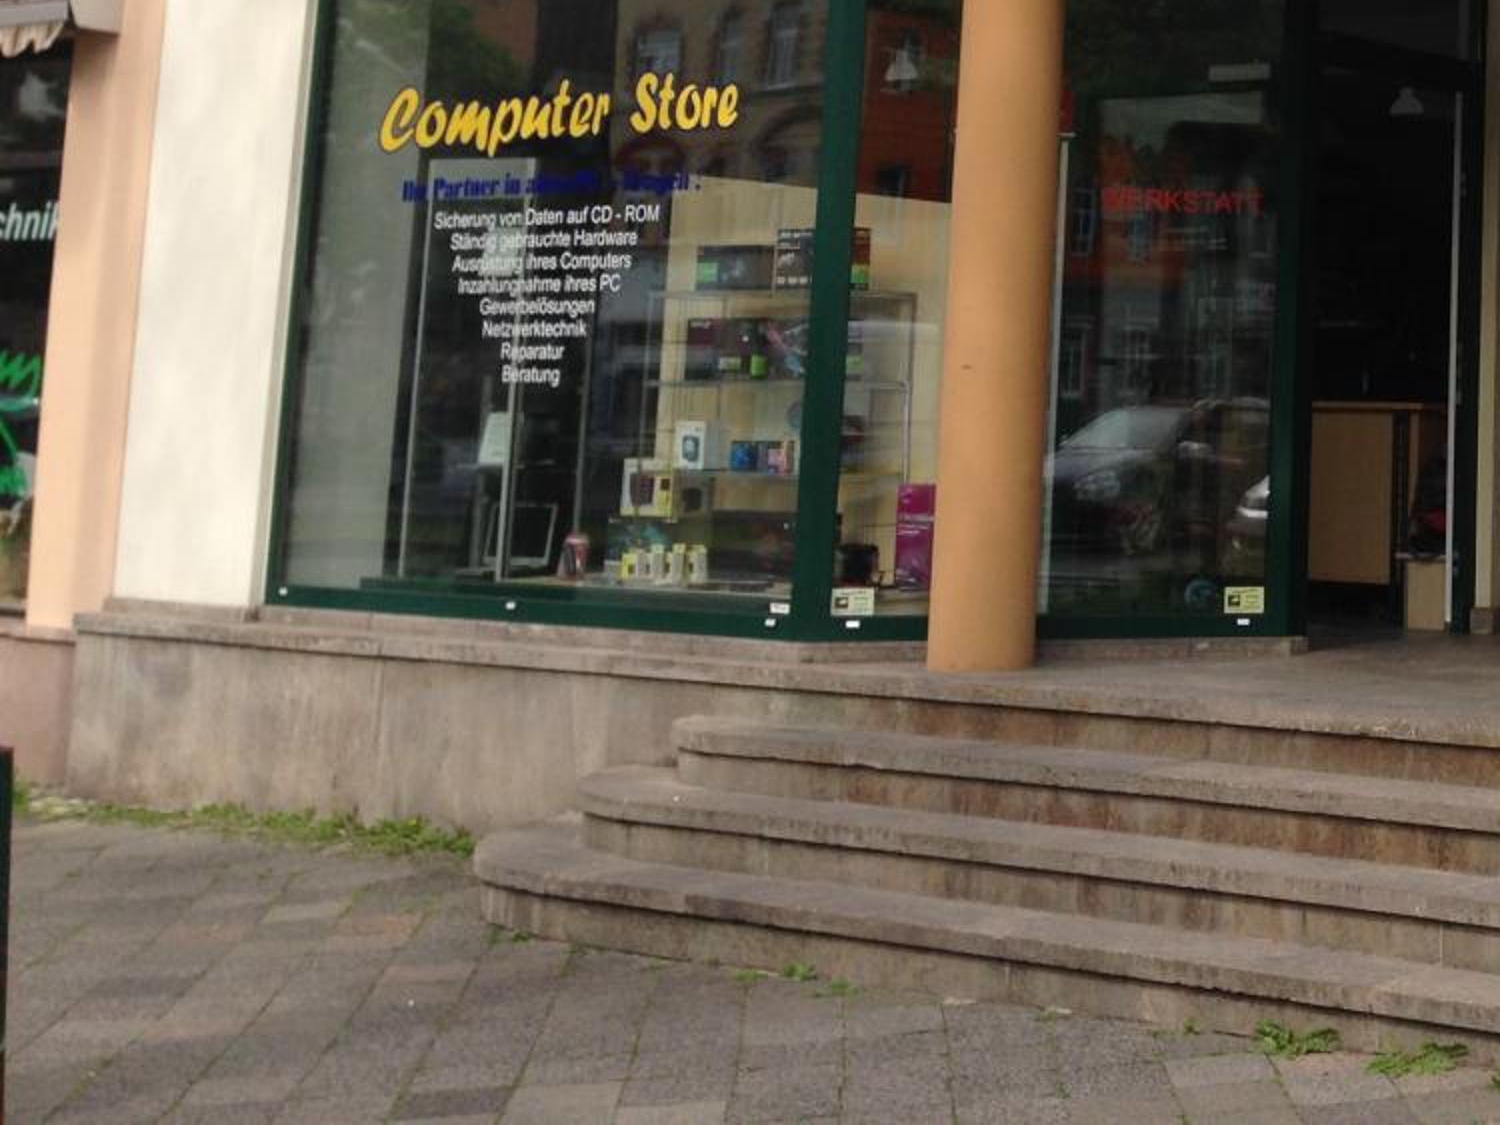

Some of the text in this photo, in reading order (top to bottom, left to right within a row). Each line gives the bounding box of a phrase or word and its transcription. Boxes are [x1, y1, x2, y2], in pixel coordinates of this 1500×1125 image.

[379, 72, 740, 158] Computer Store
[434, 211, 497, 231] Sicherung
[500, 213, 522, 227] von
[526, 207, 563, 226] Daten
[566, 205, 589, 224] auf
[591, 205, 613, 224] CD
[625, 204, 660, 222] ROM
[499, 229, 571, 253] gebrauchte
[574, 229, 638, 246] Hardware
[526, 253, 557, 271] ihres
[560, 252, 632, 273] Computers
[458, 276, 561, 296] Inzahlungnahme
[600, 272, 622, 293] PC
[480, 297, 595, 318] Gewerbelösungen
[482, 319, 587, 338] Netzwerktechnik
[501, 342, 565, 363] Reparatur
[502, 365, 560, 387] Beratung
